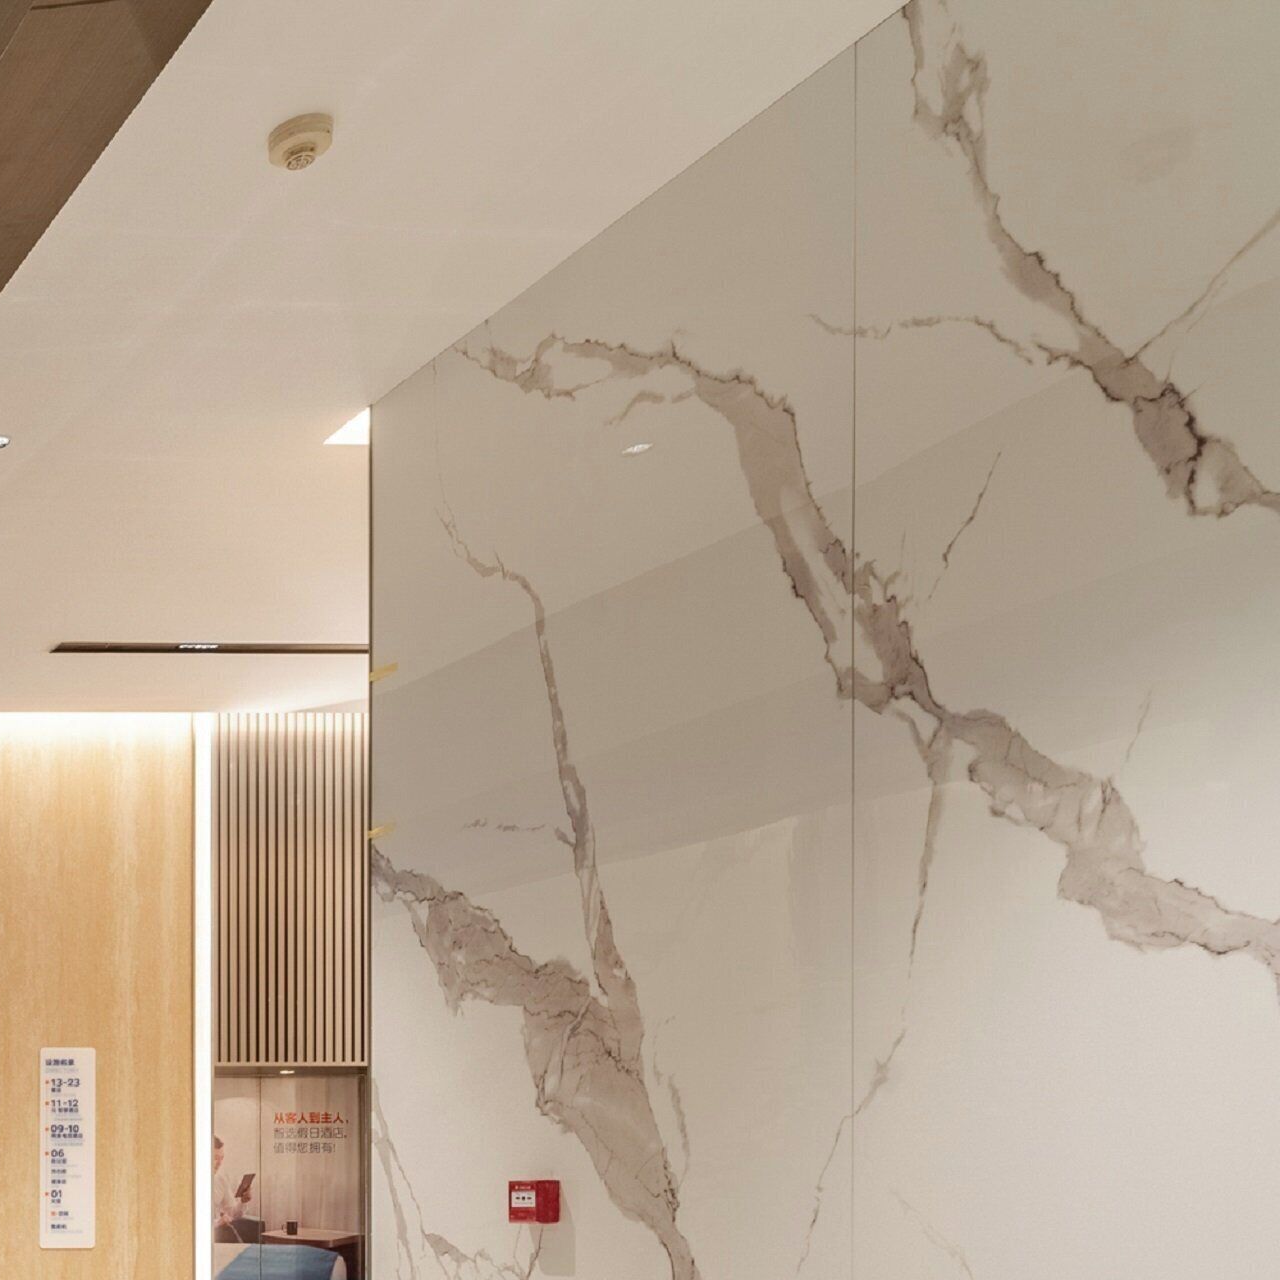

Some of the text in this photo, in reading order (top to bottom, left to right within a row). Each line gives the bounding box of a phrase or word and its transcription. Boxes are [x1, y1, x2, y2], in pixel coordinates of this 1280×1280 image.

[51, 1078, 80, 1087] 13-23
[51, 1099, 79, 1107] 11-12
[51, 1124, 79, 1133] 09-10
[51, 1149, 65, 1157] 06
[51, 1190, 62, 1198] 01
